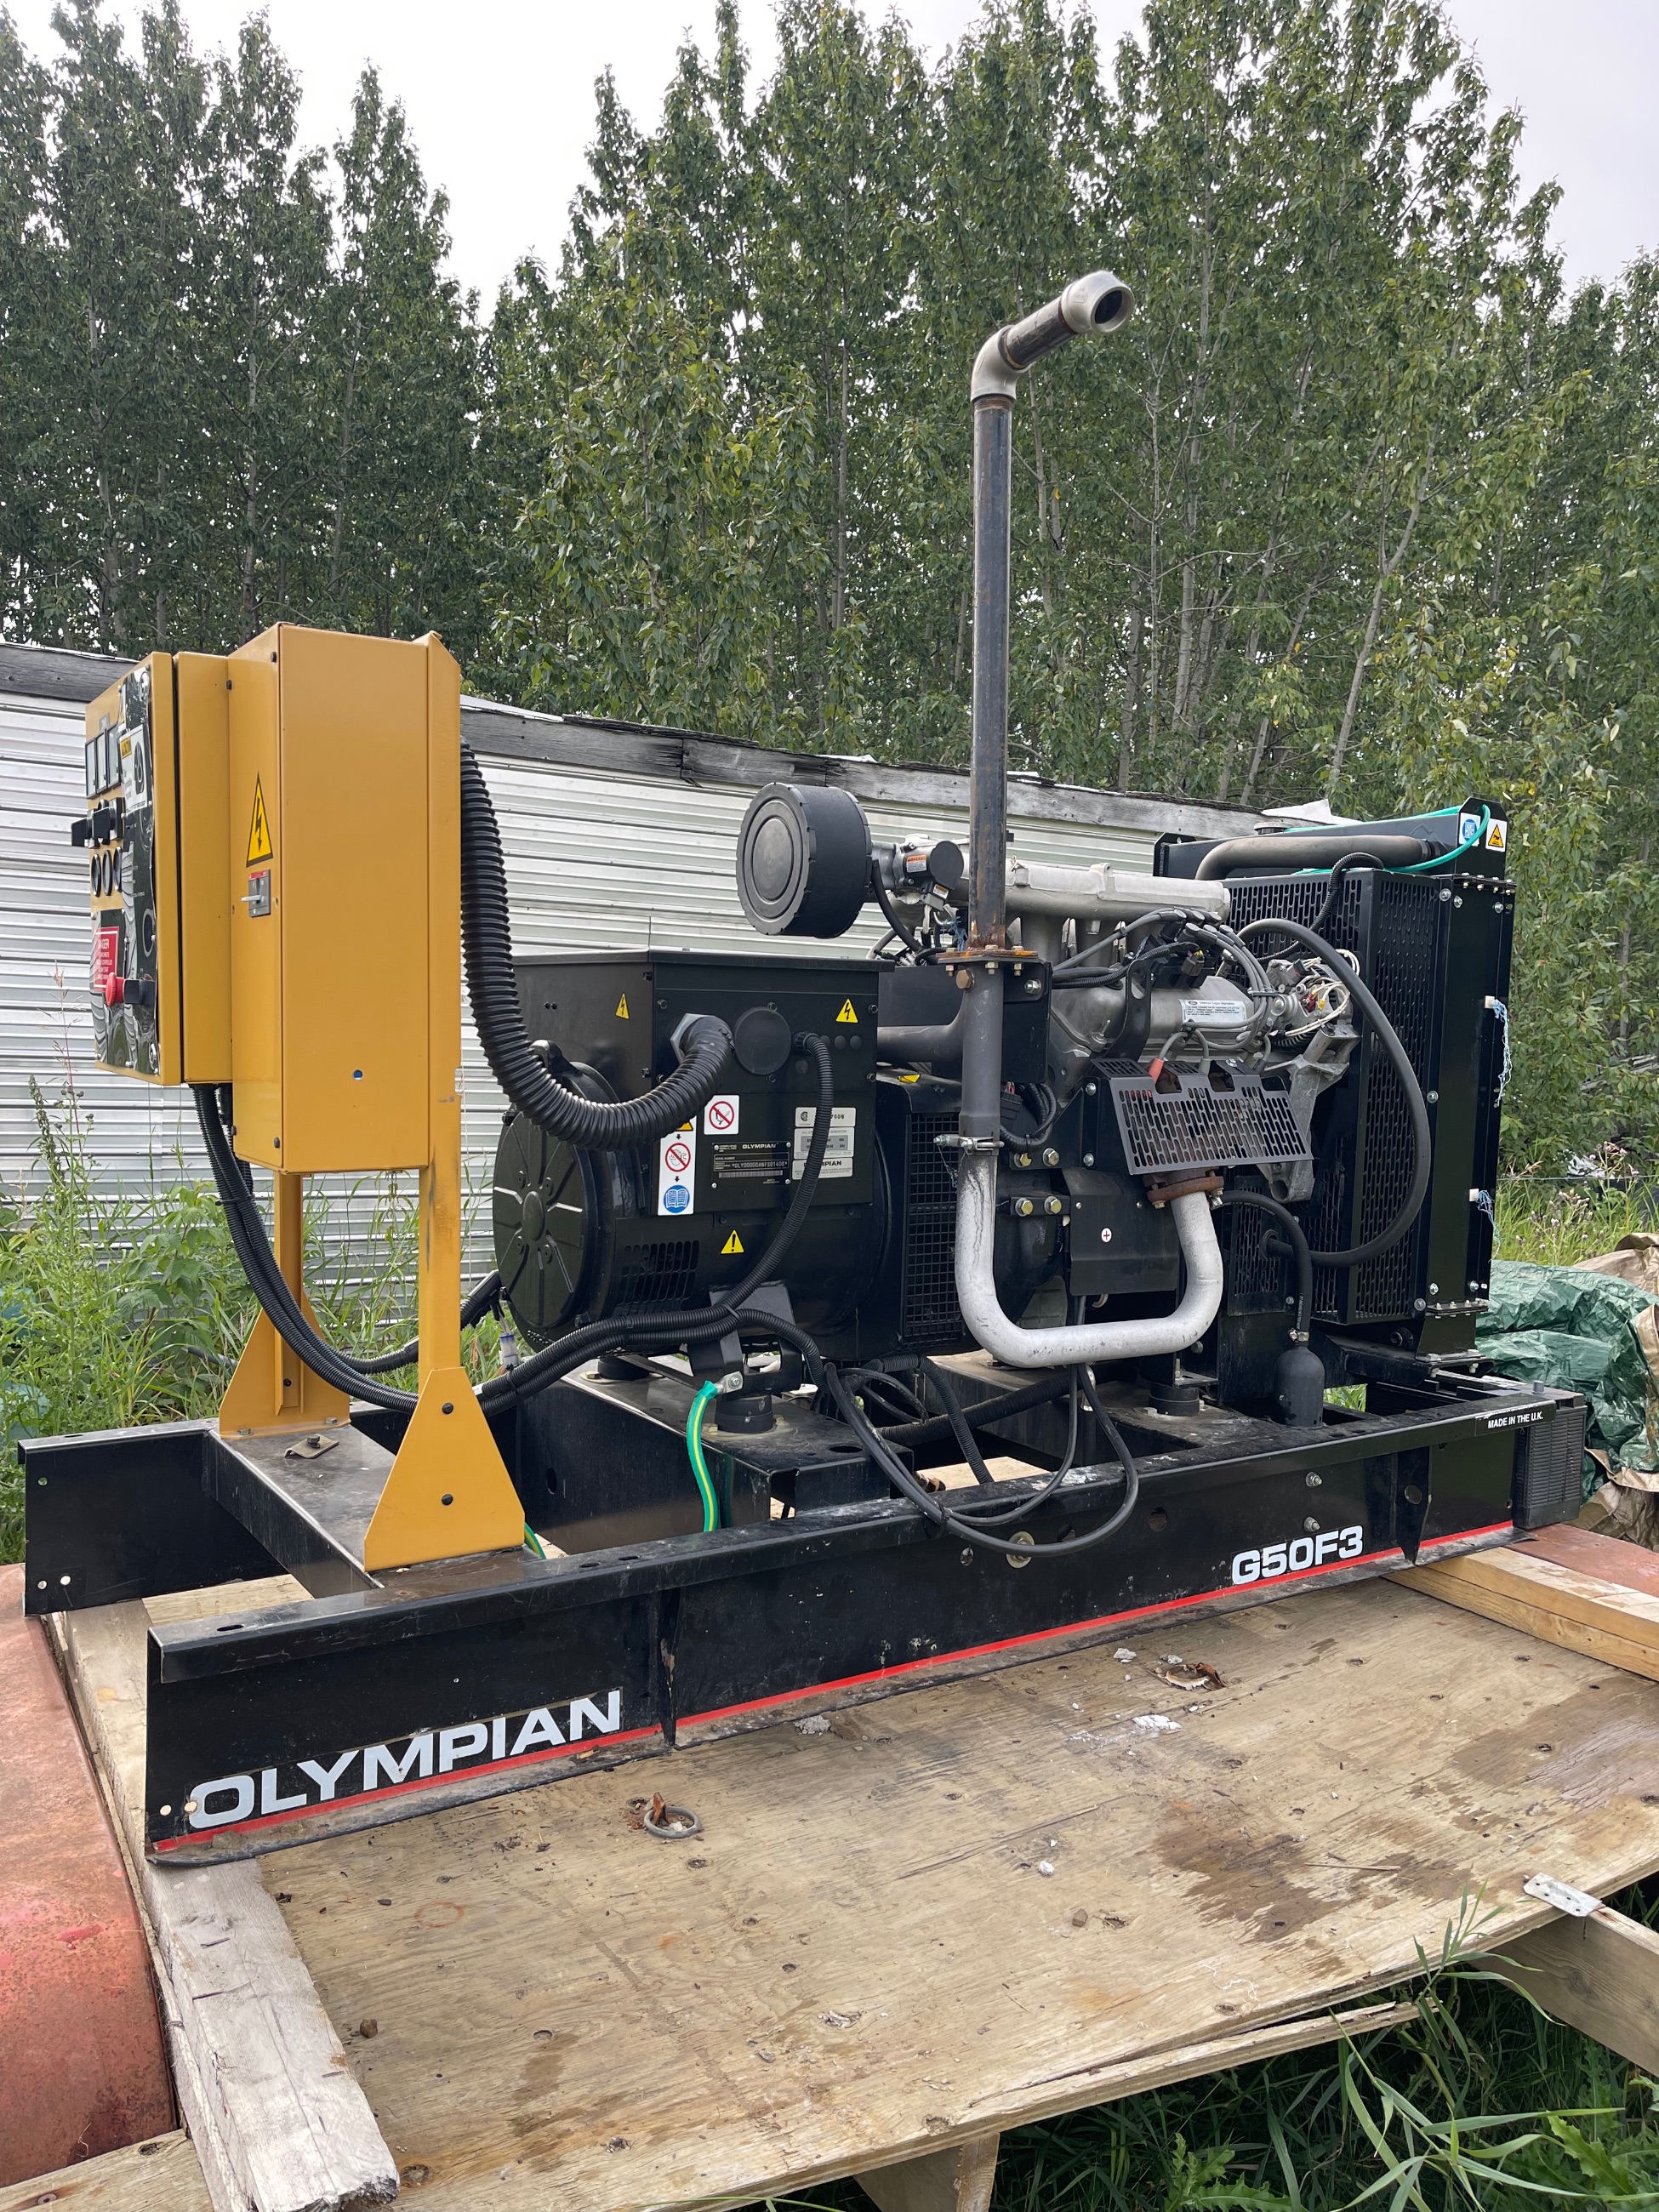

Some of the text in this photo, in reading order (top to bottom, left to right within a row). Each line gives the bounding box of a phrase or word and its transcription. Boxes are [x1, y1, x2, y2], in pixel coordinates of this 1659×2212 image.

[1488, 1411, 1543, 1428] MADE IN THE U.K.
[1231, 1525, 1364, 1586] G50F3
[188, 1689, 622, 1830] OLYMPIAN
